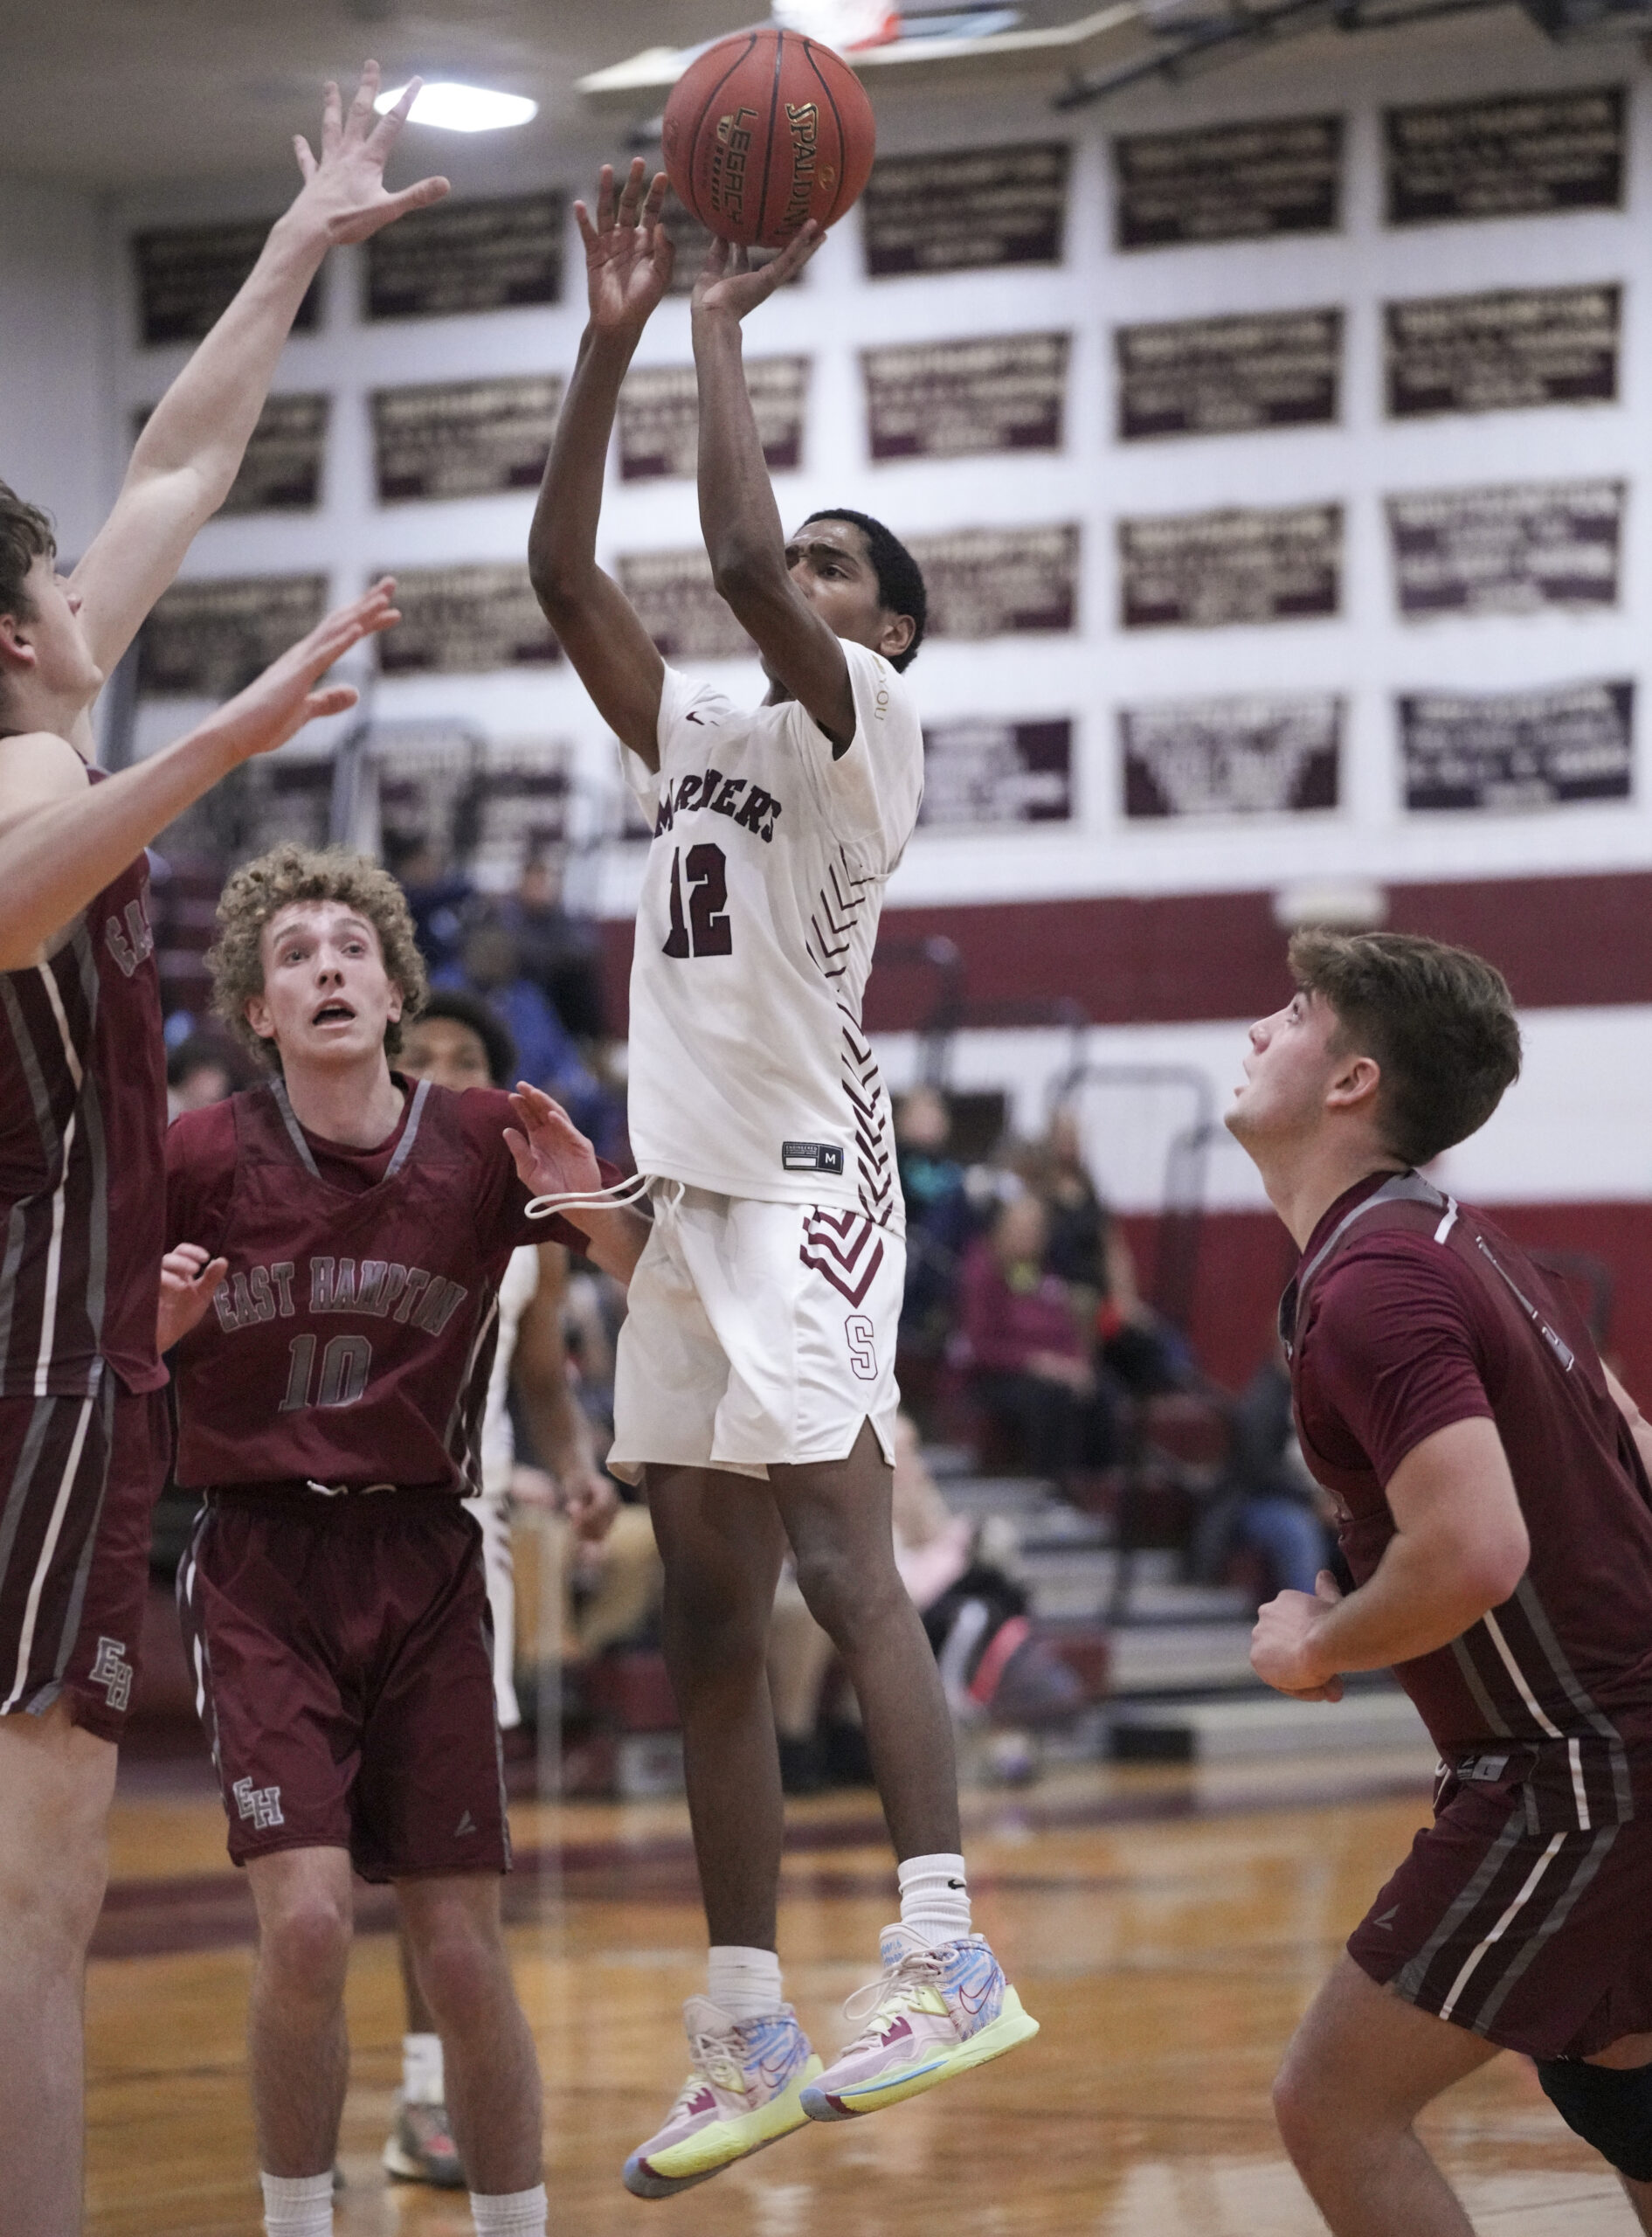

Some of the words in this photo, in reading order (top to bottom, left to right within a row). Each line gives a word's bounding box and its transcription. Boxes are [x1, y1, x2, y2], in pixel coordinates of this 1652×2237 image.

[724, 107, 758, 224] LEGACY
[661, 843, 732, 958] 12
[825, 1153, 836, 1165] M
[213, 1262, 295, 1333] EAST
[278, 1333, 372, 1412] 10
[845, 1315, 878, 1381] S
